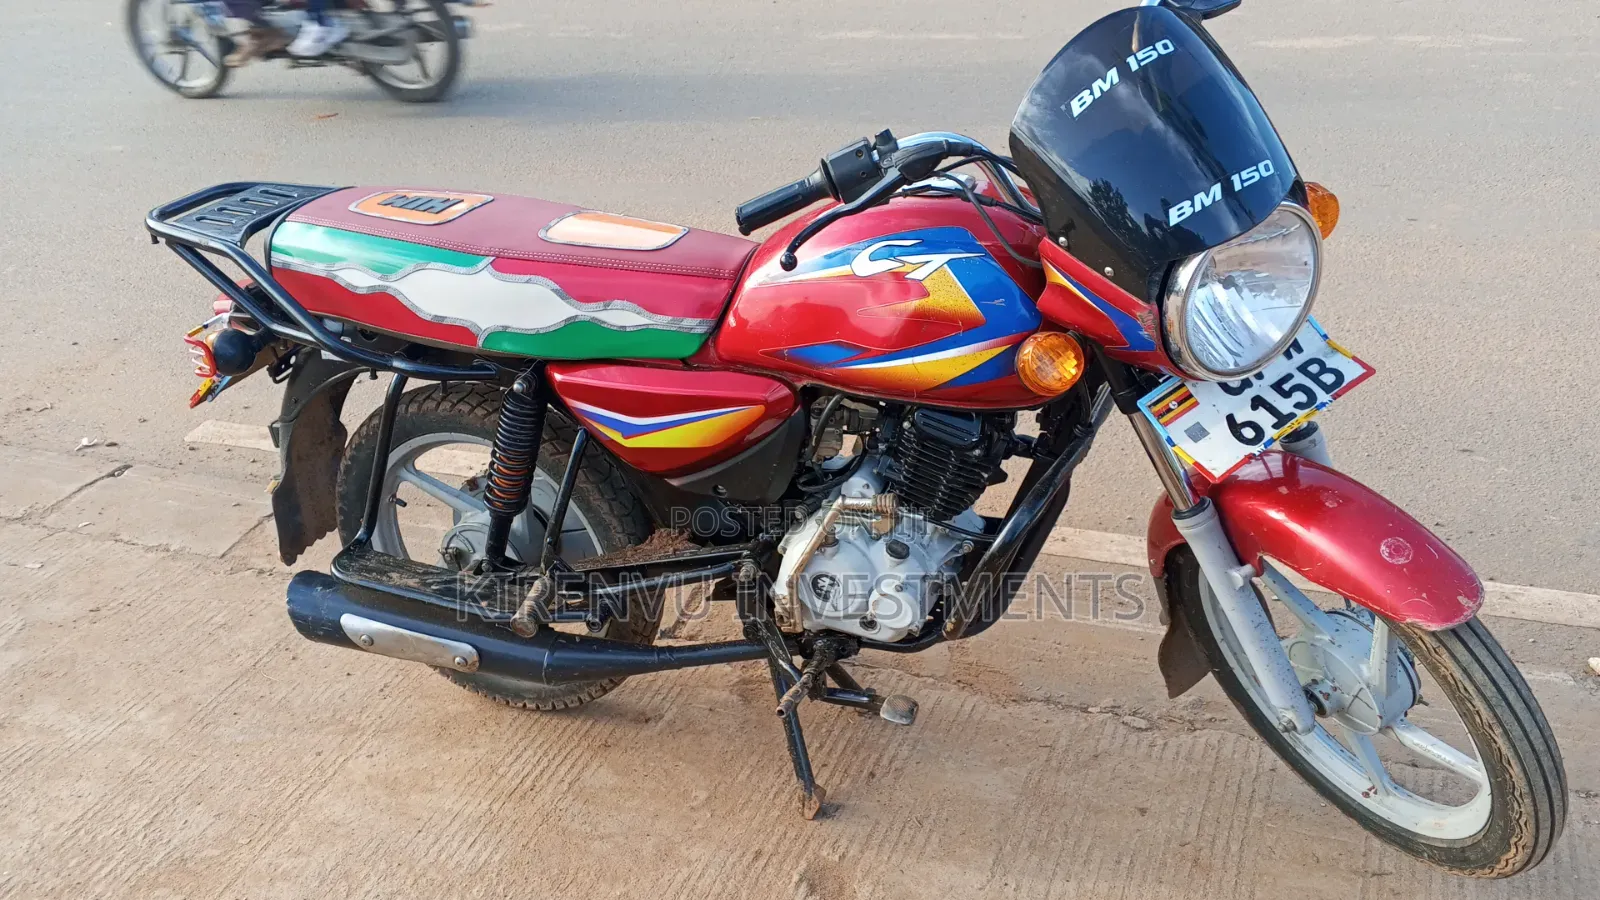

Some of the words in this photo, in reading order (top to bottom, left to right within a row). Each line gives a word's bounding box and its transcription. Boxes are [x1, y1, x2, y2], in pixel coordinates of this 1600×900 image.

[1069, 66, 1120, 119] BM
[1125, 38, 1175, 73] 150
[1168, 182, 1222, 228] BM
[1230, 159, 1276, 193] 150
[1225, 357, 1345, 446] 615B
